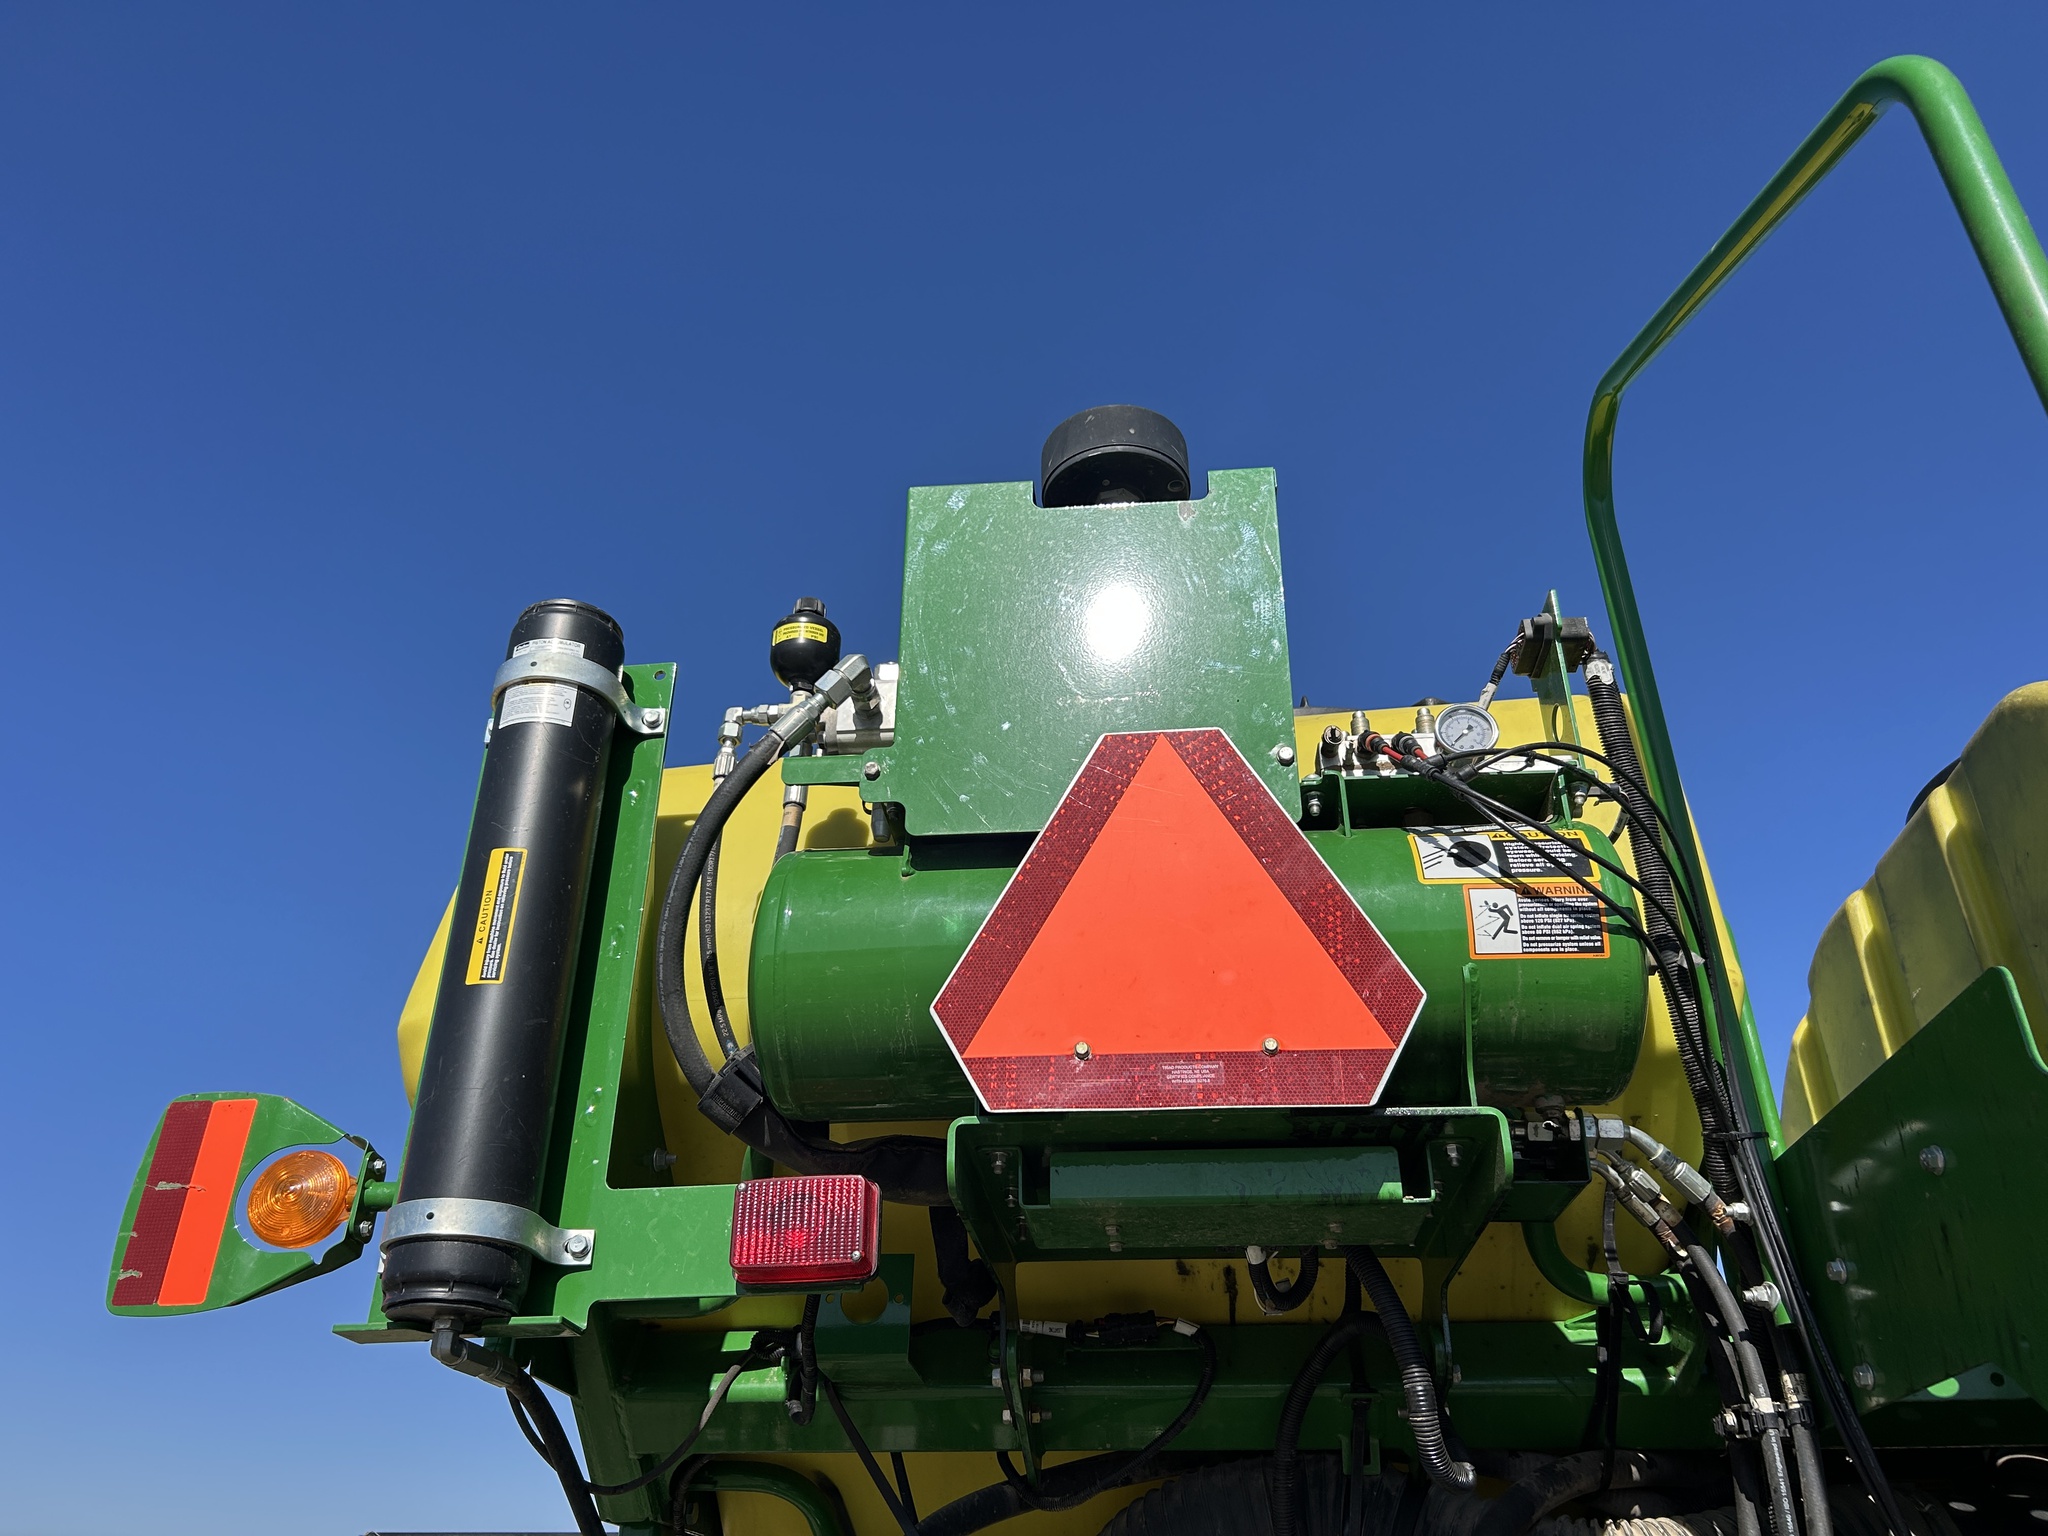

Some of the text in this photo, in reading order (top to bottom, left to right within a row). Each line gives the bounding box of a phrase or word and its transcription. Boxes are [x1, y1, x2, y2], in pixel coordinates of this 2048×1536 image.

[706, 876, 714, 887] SAE
[1531, 885, 1592, 896] WARNIN
[479, 889, 493, 932] CAUTION
[1772, 1443, 1783, 1477] Engineered
[1782, 1497, 1790, 1510] ISO
